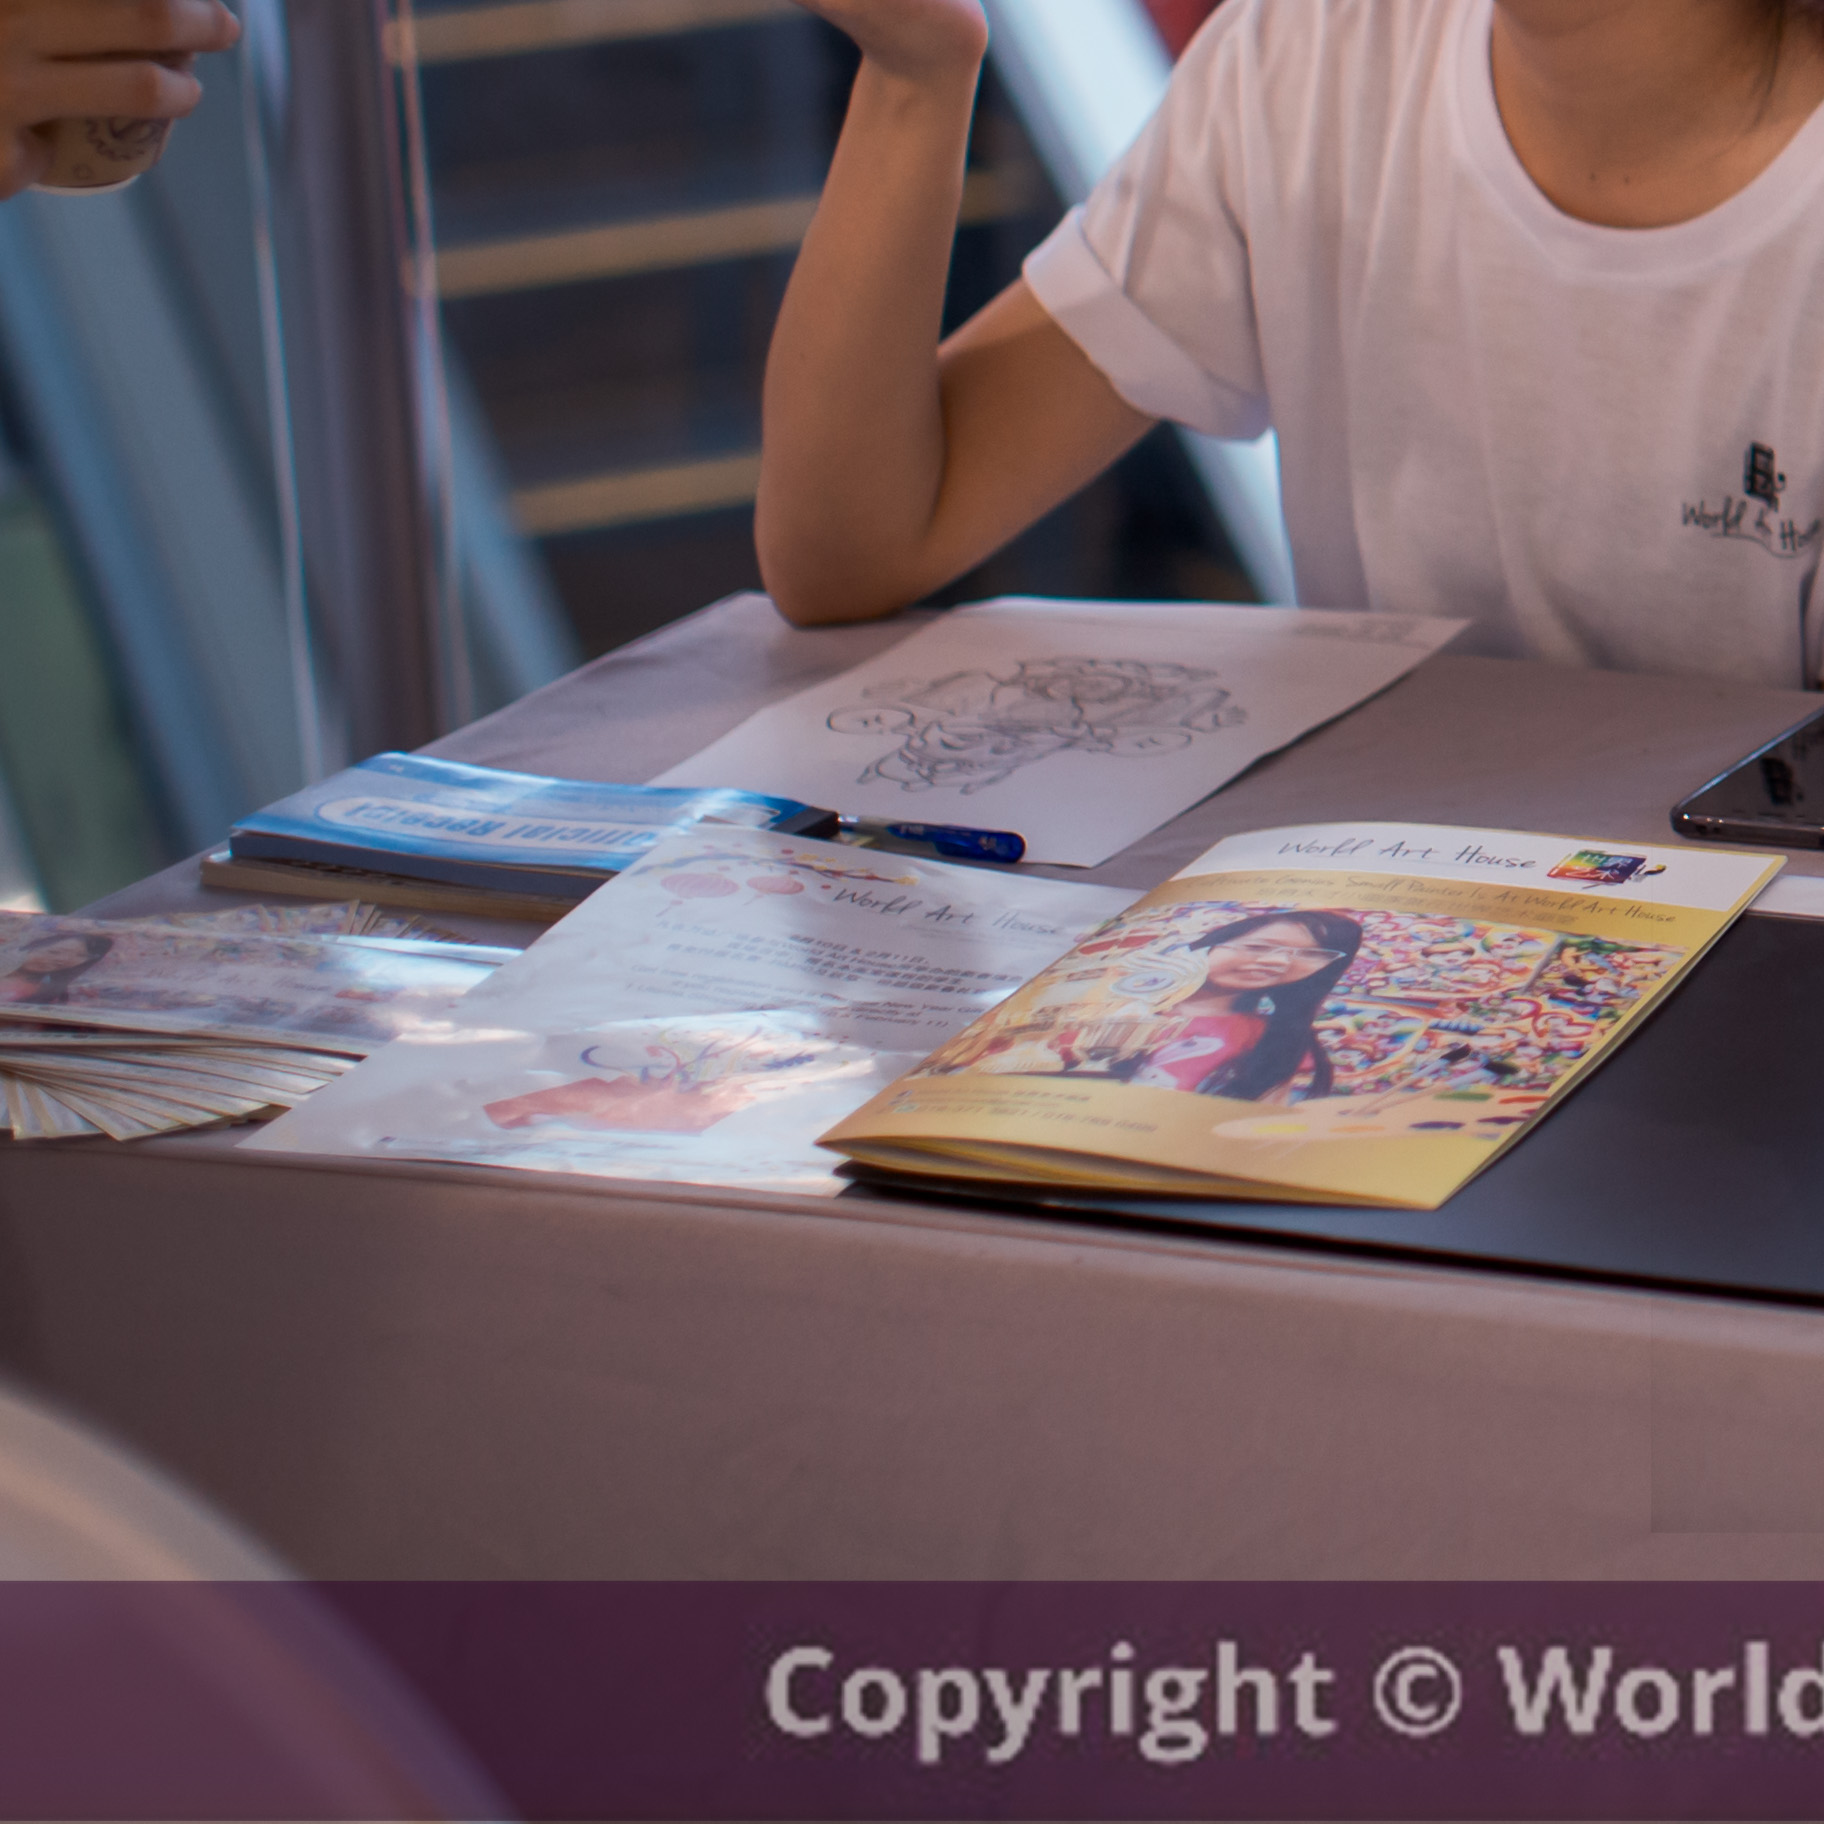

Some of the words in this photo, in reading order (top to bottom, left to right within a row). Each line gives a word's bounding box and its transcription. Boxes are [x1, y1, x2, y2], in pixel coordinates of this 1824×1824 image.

[1278, 836, 1375, 858] World
[1378, 839, 1440, 860] Art
[1454, 844, 1538, 870] House
[833, 887, 924, 917] World
[924, 903, 976, 925] Art
